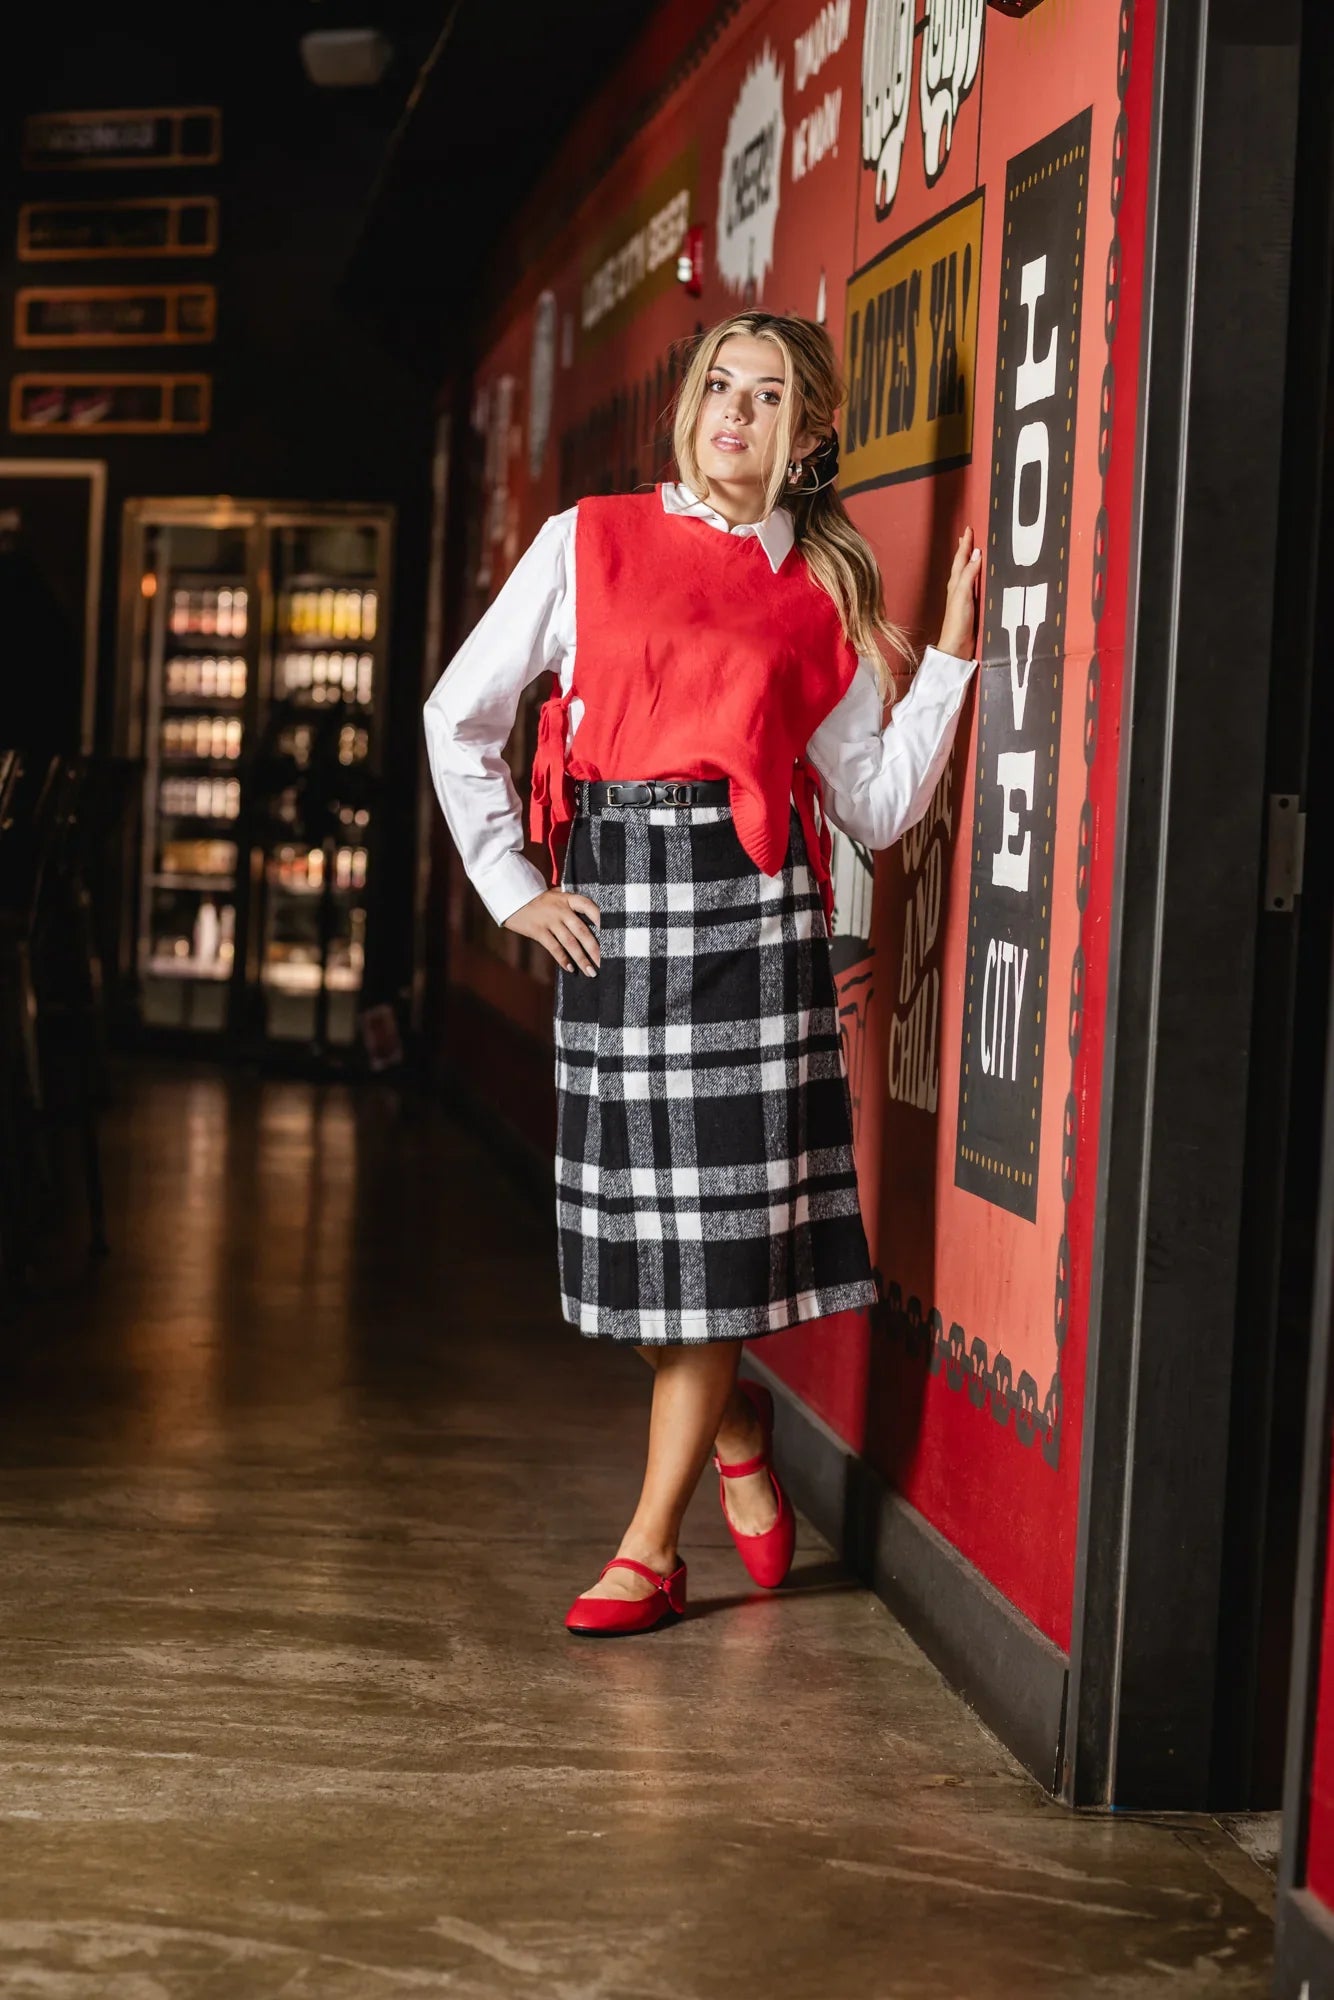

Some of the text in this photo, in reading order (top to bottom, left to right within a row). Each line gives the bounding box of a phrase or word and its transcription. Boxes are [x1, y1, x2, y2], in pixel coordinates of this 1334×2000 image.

[845, 242, 972, 454] LOVES YA!
[992, 254, 1059, 892] LOVE
[899, 838, 942, 1004] AND
[888, 966, 940, 1113] CHILL
[980, 938, 1029, 1081] CITY
